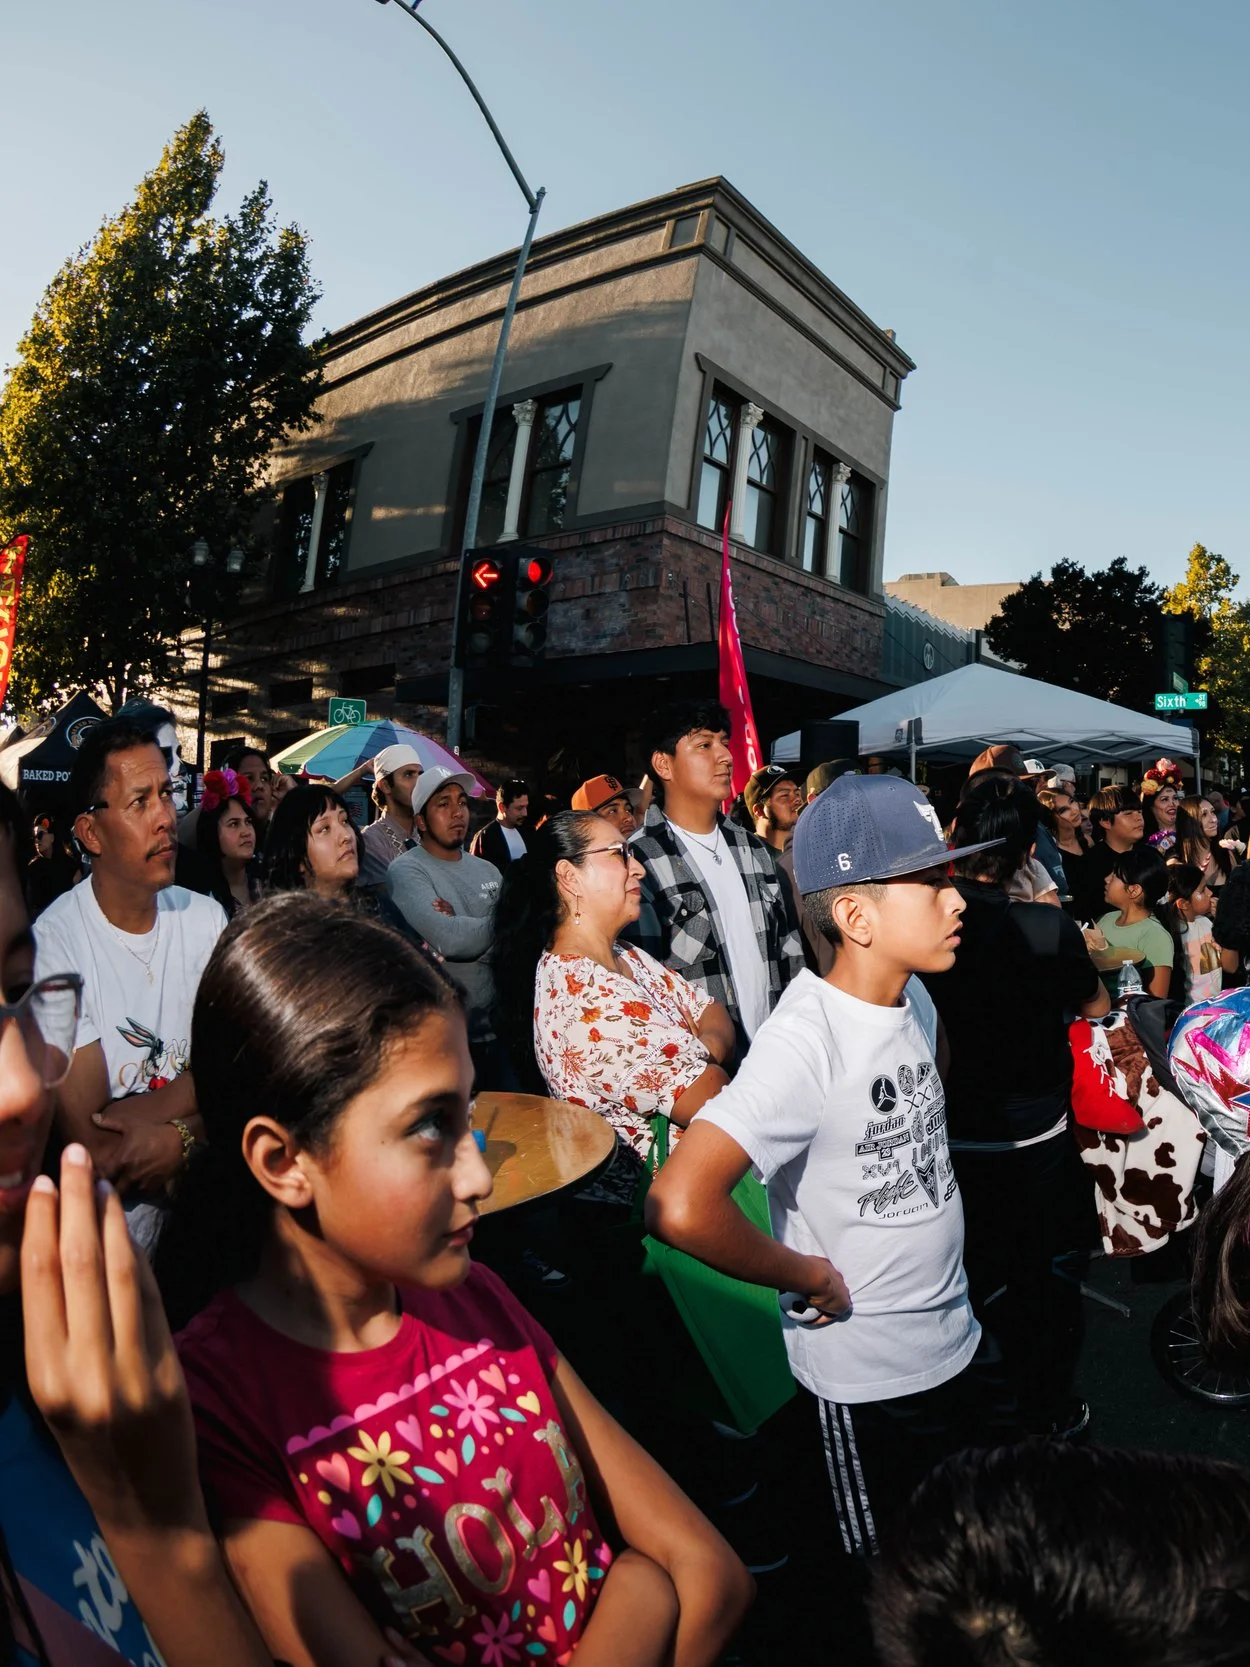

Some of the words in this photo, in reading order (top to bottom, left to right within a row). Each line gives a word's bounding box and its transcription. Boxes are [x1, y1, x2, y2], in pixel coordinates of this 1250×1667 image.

[1157, 695, 1187, 708] Sixth
[23, 769, 54, 782] BAKED
[56, 770, 72, 782] PO
[837, 853, 851, 871] 6
[858, 1143, 876, 1154] AIR
[875, 1133, 910, 1151] JORDAN
